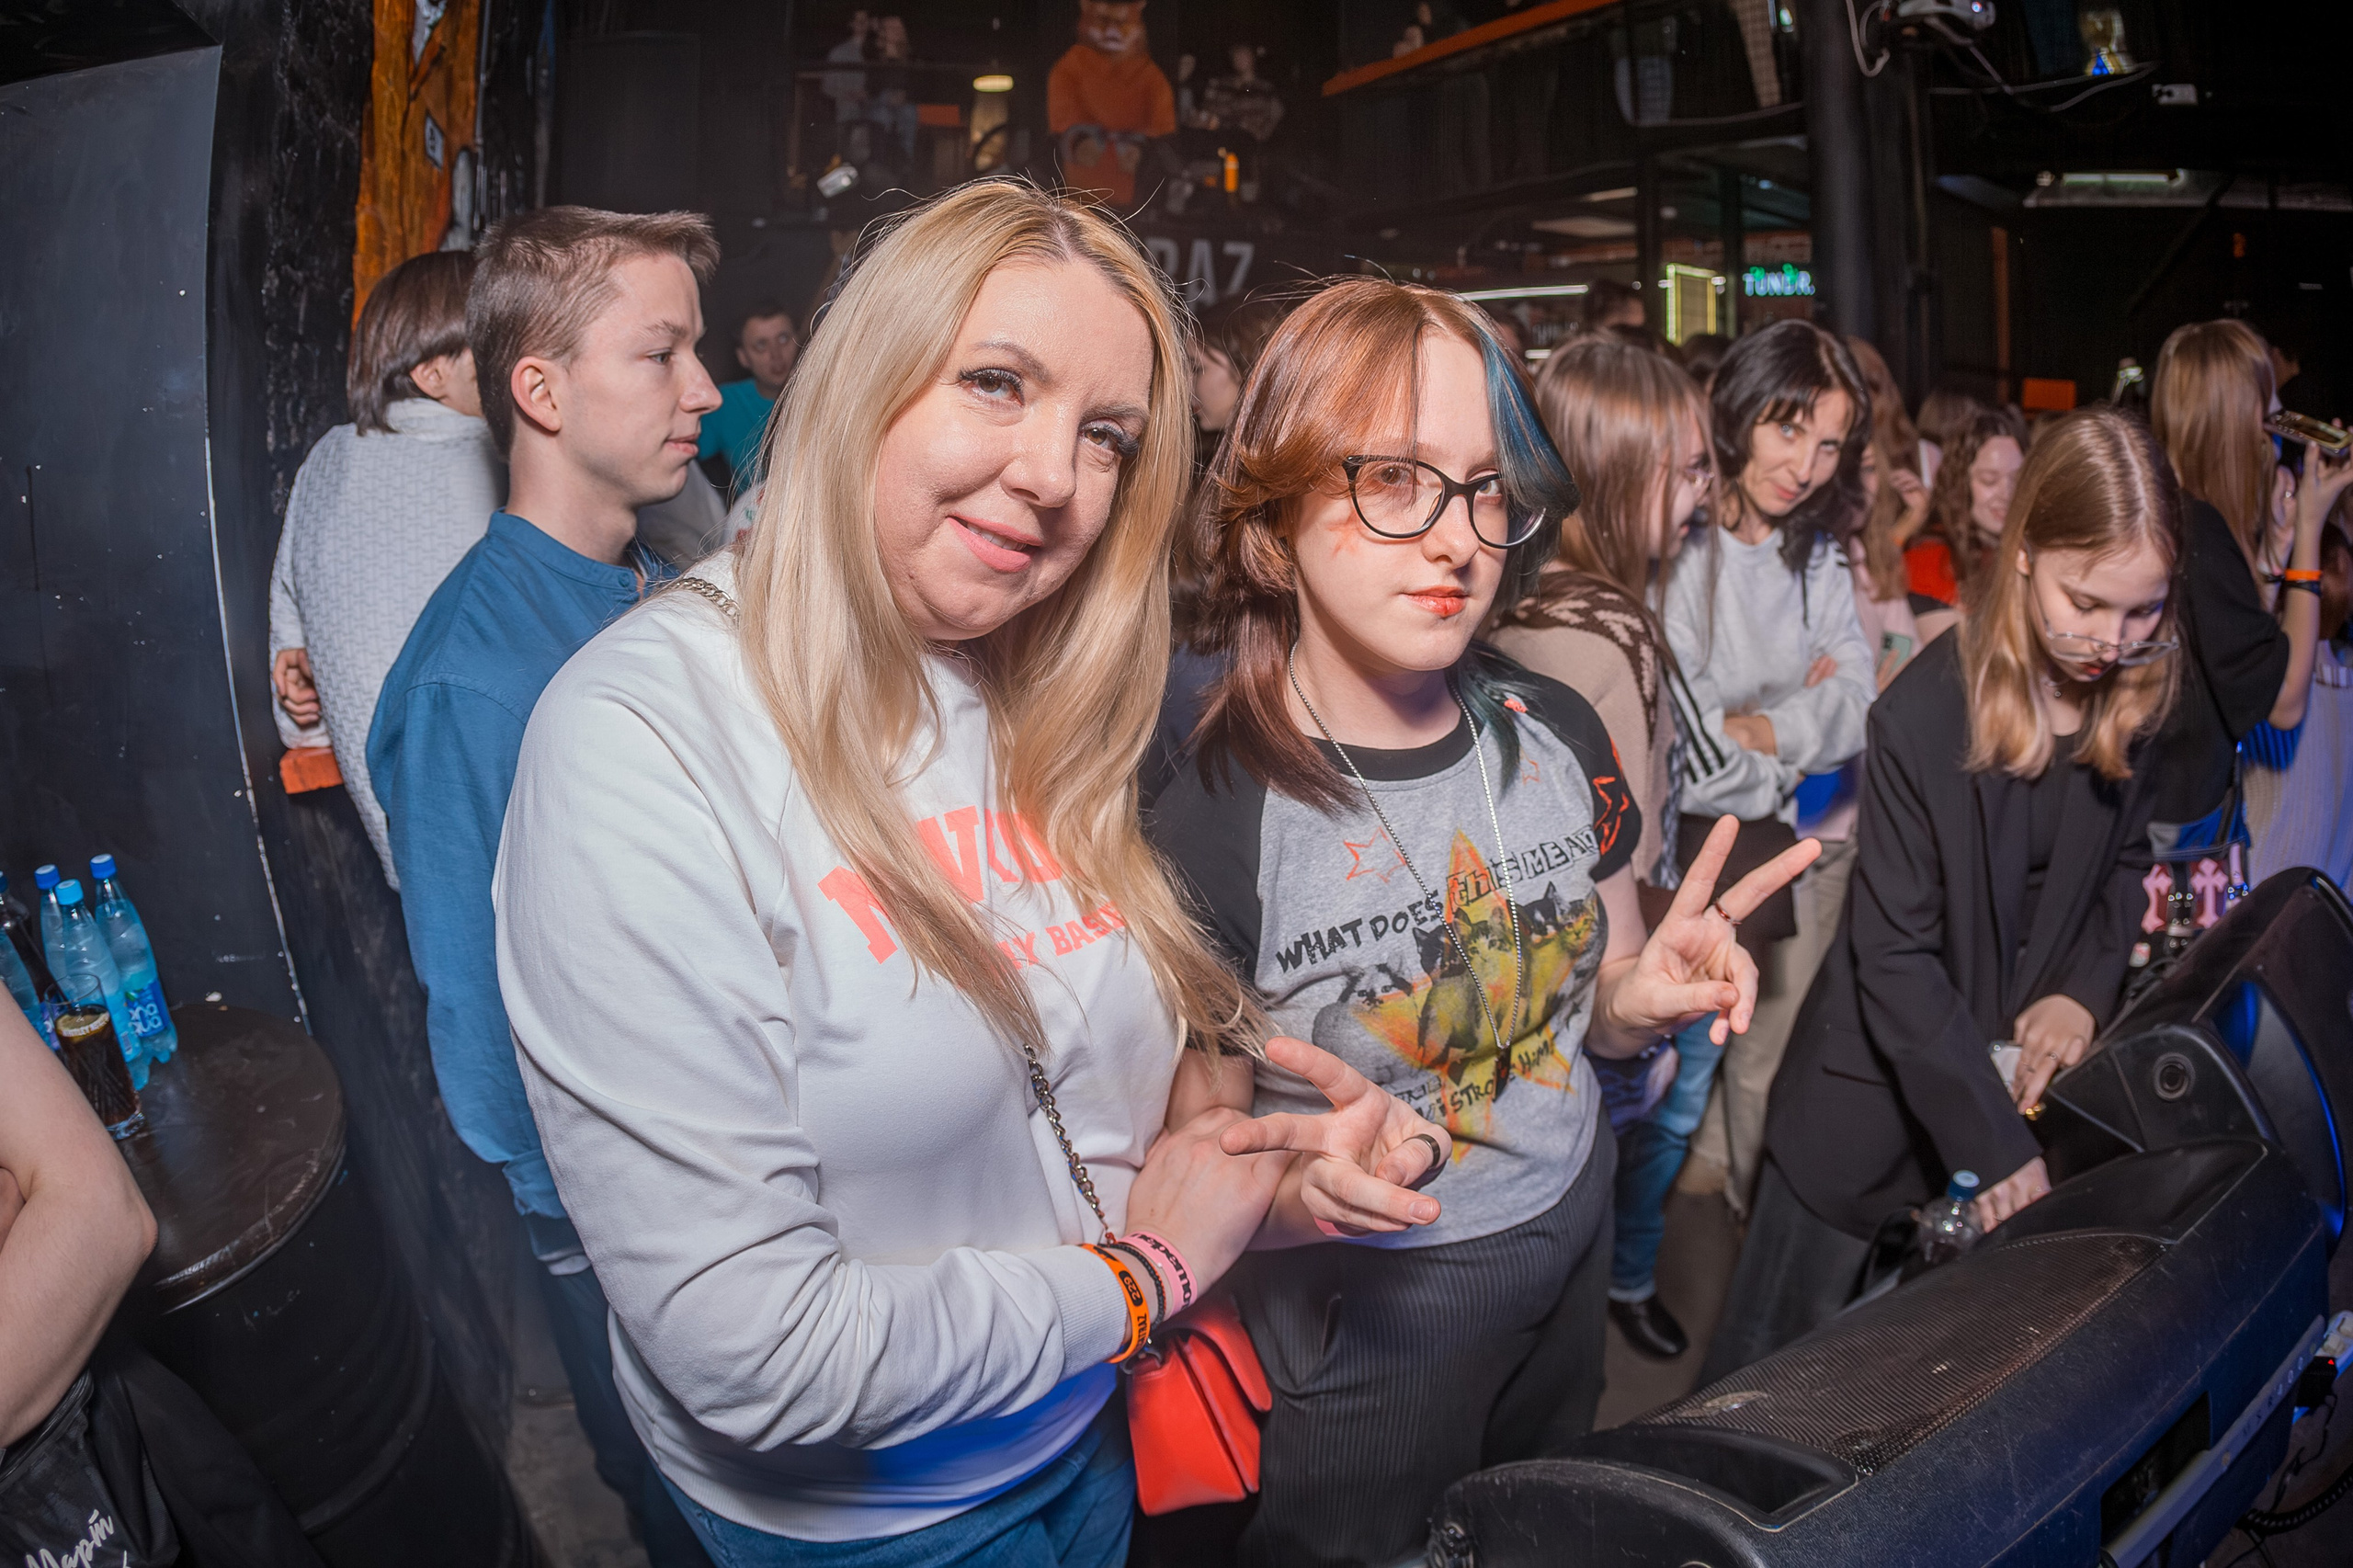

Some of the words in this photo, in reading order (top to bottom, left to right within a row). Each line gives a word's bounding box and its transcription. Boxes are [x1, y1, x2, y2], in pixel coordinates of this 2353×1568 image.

[1276, 918, 1362, 972] WHAT
[1370, 890, 1443, 941] DOES
[1124, 1276, 1141, 1301] 229
